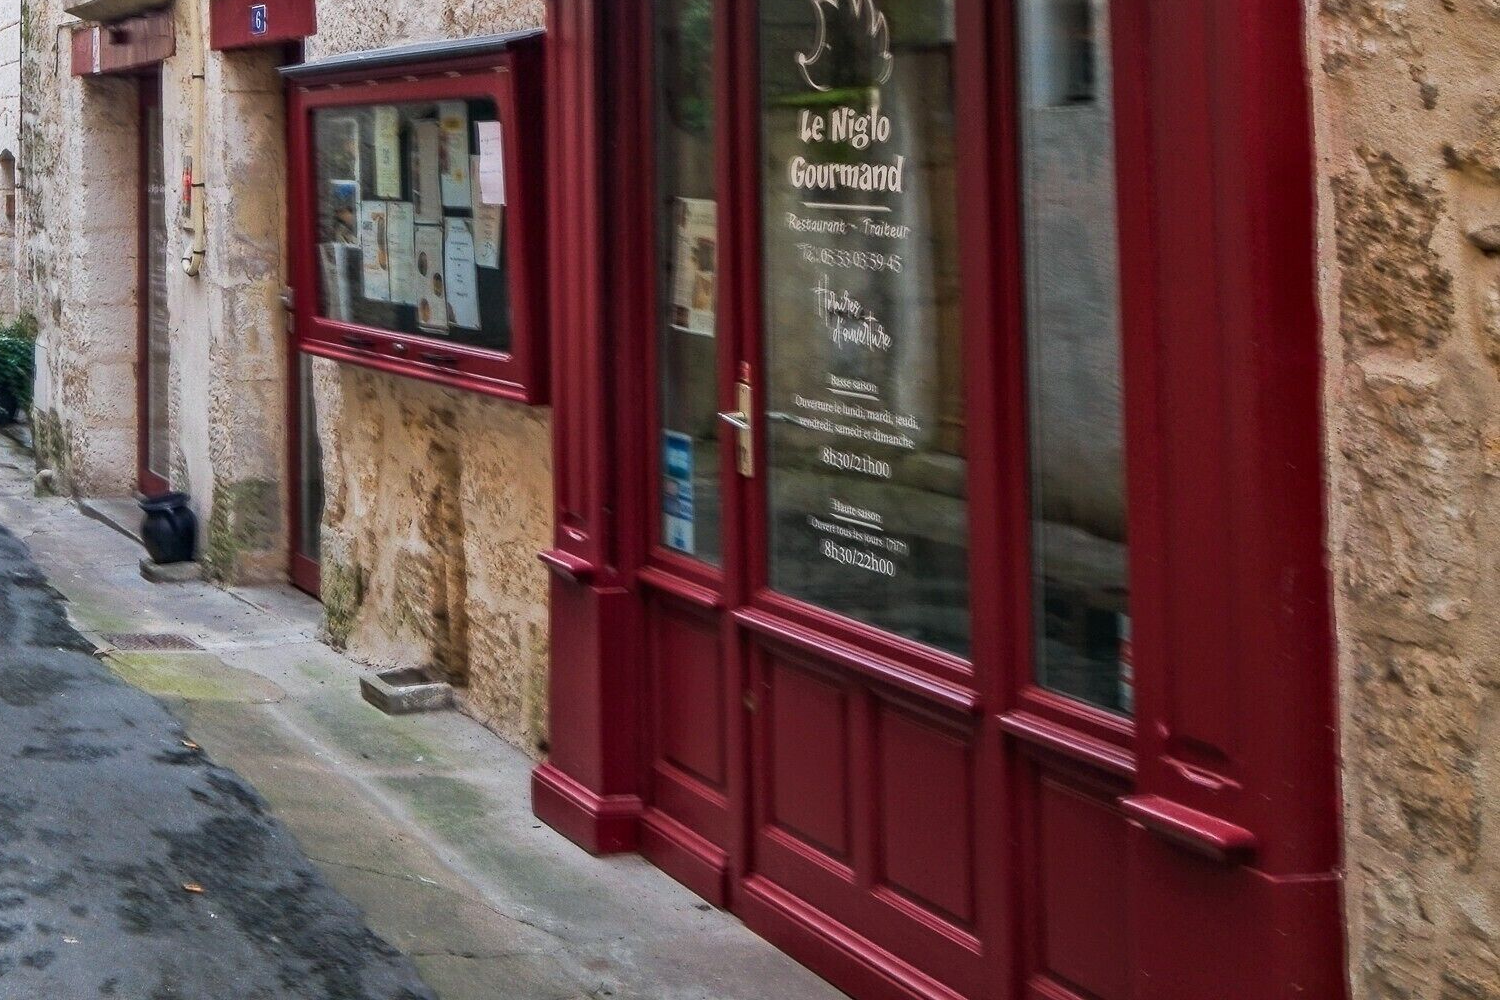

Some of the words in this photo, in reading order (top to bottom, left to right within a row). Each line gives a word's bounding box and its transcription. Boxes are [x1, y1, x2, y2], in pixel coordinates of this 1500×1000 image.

[255, 10, 261, 29] 6
[801, 109, 824, 143] Le
[832, 106, 890, 149] Niglo
[791, 155, 905, 194] Gourmand
[787, 213, 846, 234] Restaurant
[862, 218, 911, 239] Traiteur
[823, 446, 891, 479] 8h30/21h00
[824, 539, 895, 577] 8h30/22h00
